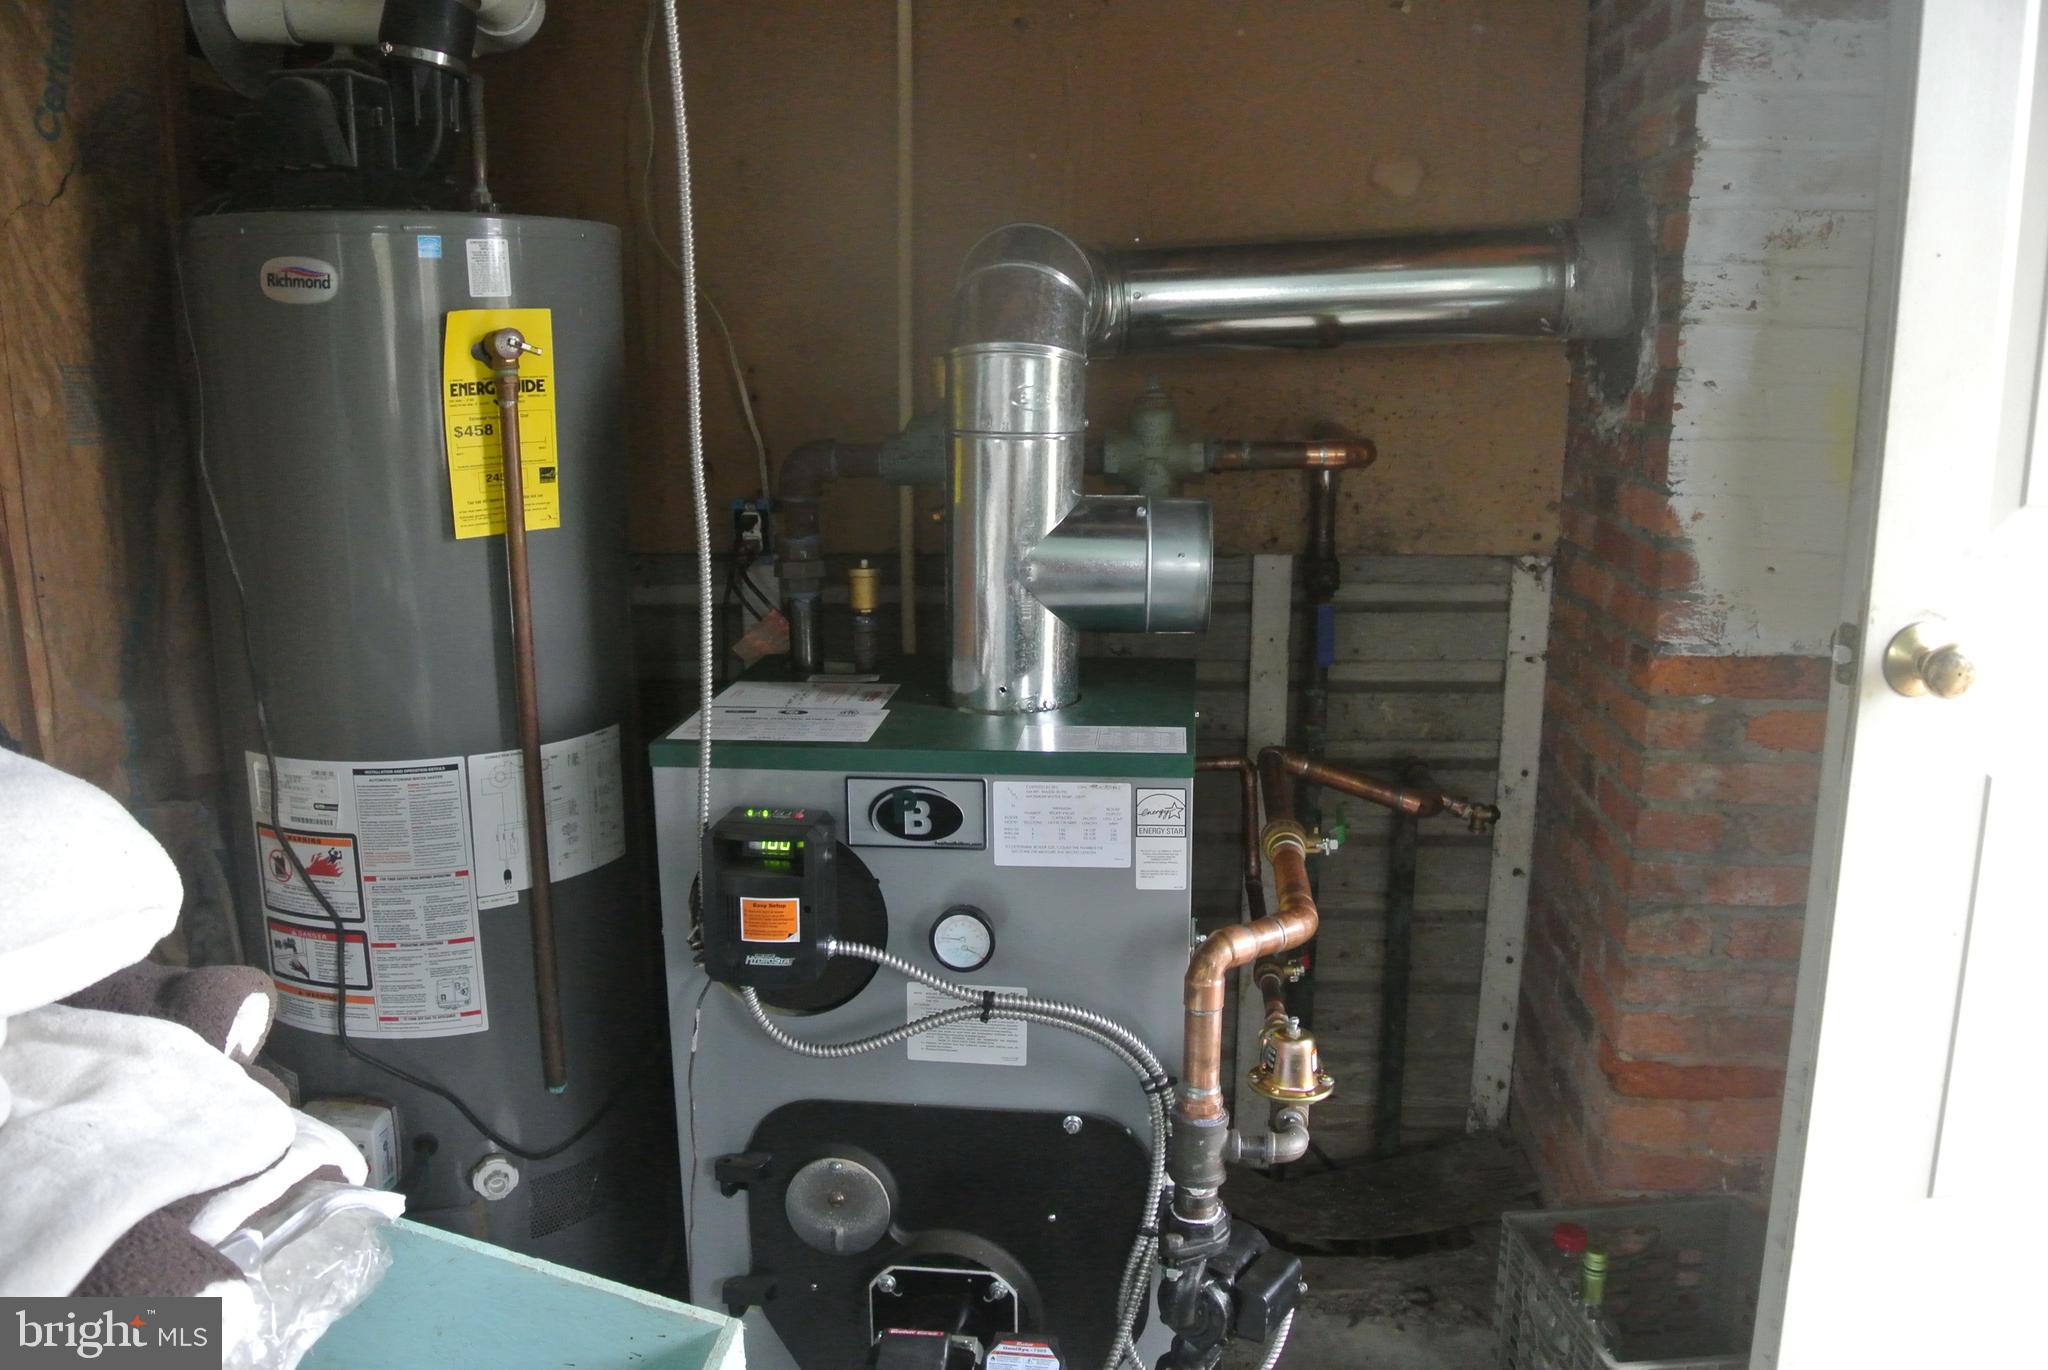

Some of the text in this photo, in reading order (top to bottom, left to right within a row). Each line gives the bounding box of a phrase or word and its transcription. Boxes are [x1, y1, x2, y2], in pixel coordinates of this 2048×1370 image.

[267, 273, 331, 289] Richmond
[450, 379, 546, 397] ENERGIDE
[454, 424, 493, 438] $458
